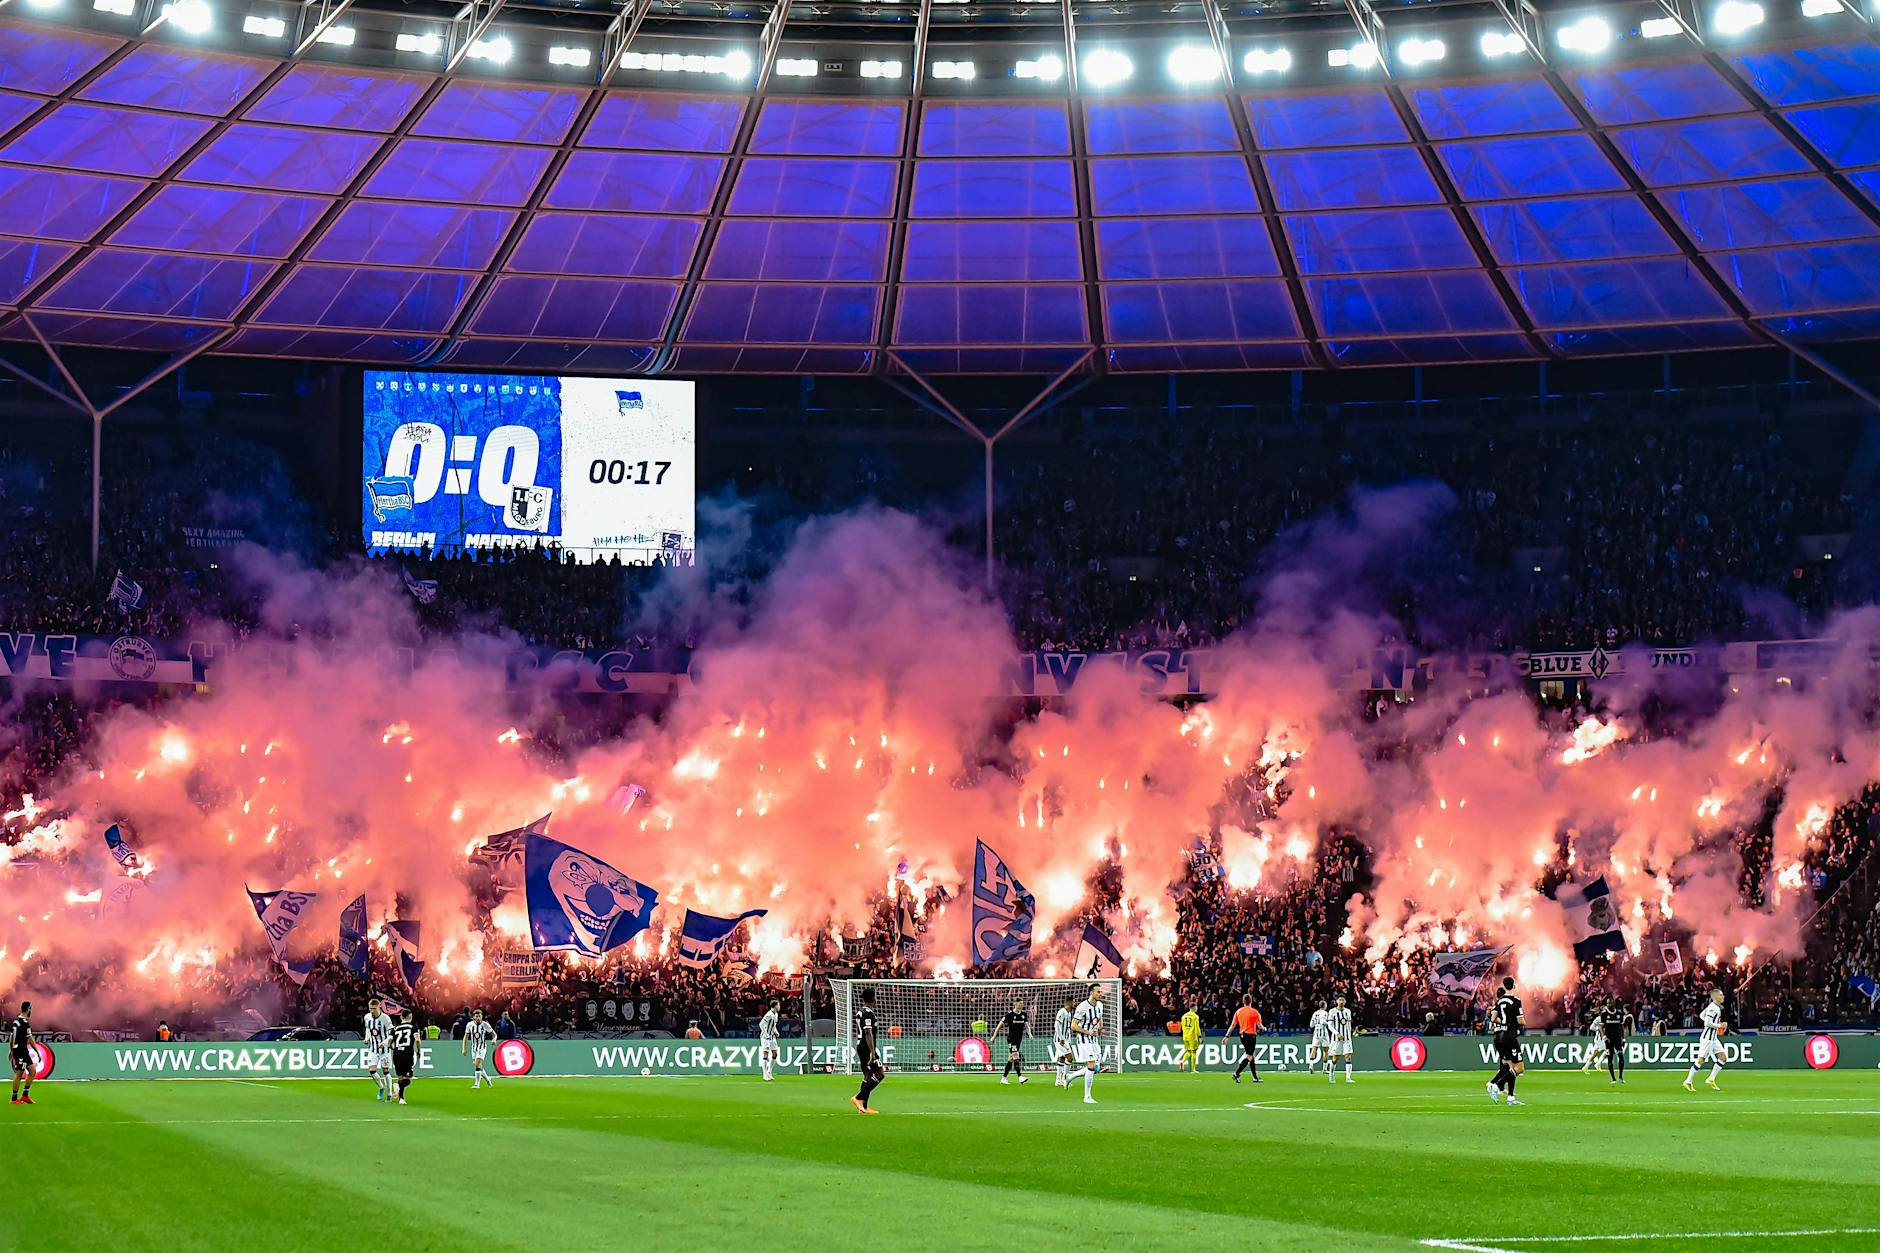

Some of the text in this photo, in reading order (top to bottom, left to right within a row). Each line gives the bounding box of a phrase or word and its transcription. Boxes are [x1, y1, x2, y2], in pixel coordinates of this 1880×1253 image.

[589, 459, 671, 485] 00:17
[371, 531, 436, 547] BERLIN
[1531, 656, 1582, 673] BLUE
[395, 1029, 411, 1047] 23
[502, 1045, 524, 1072] B
[961, 1043, 983, 1064] B
[1398, 1042, 1418, 1066] B
[1813, 1041, 1832, 1064] B
